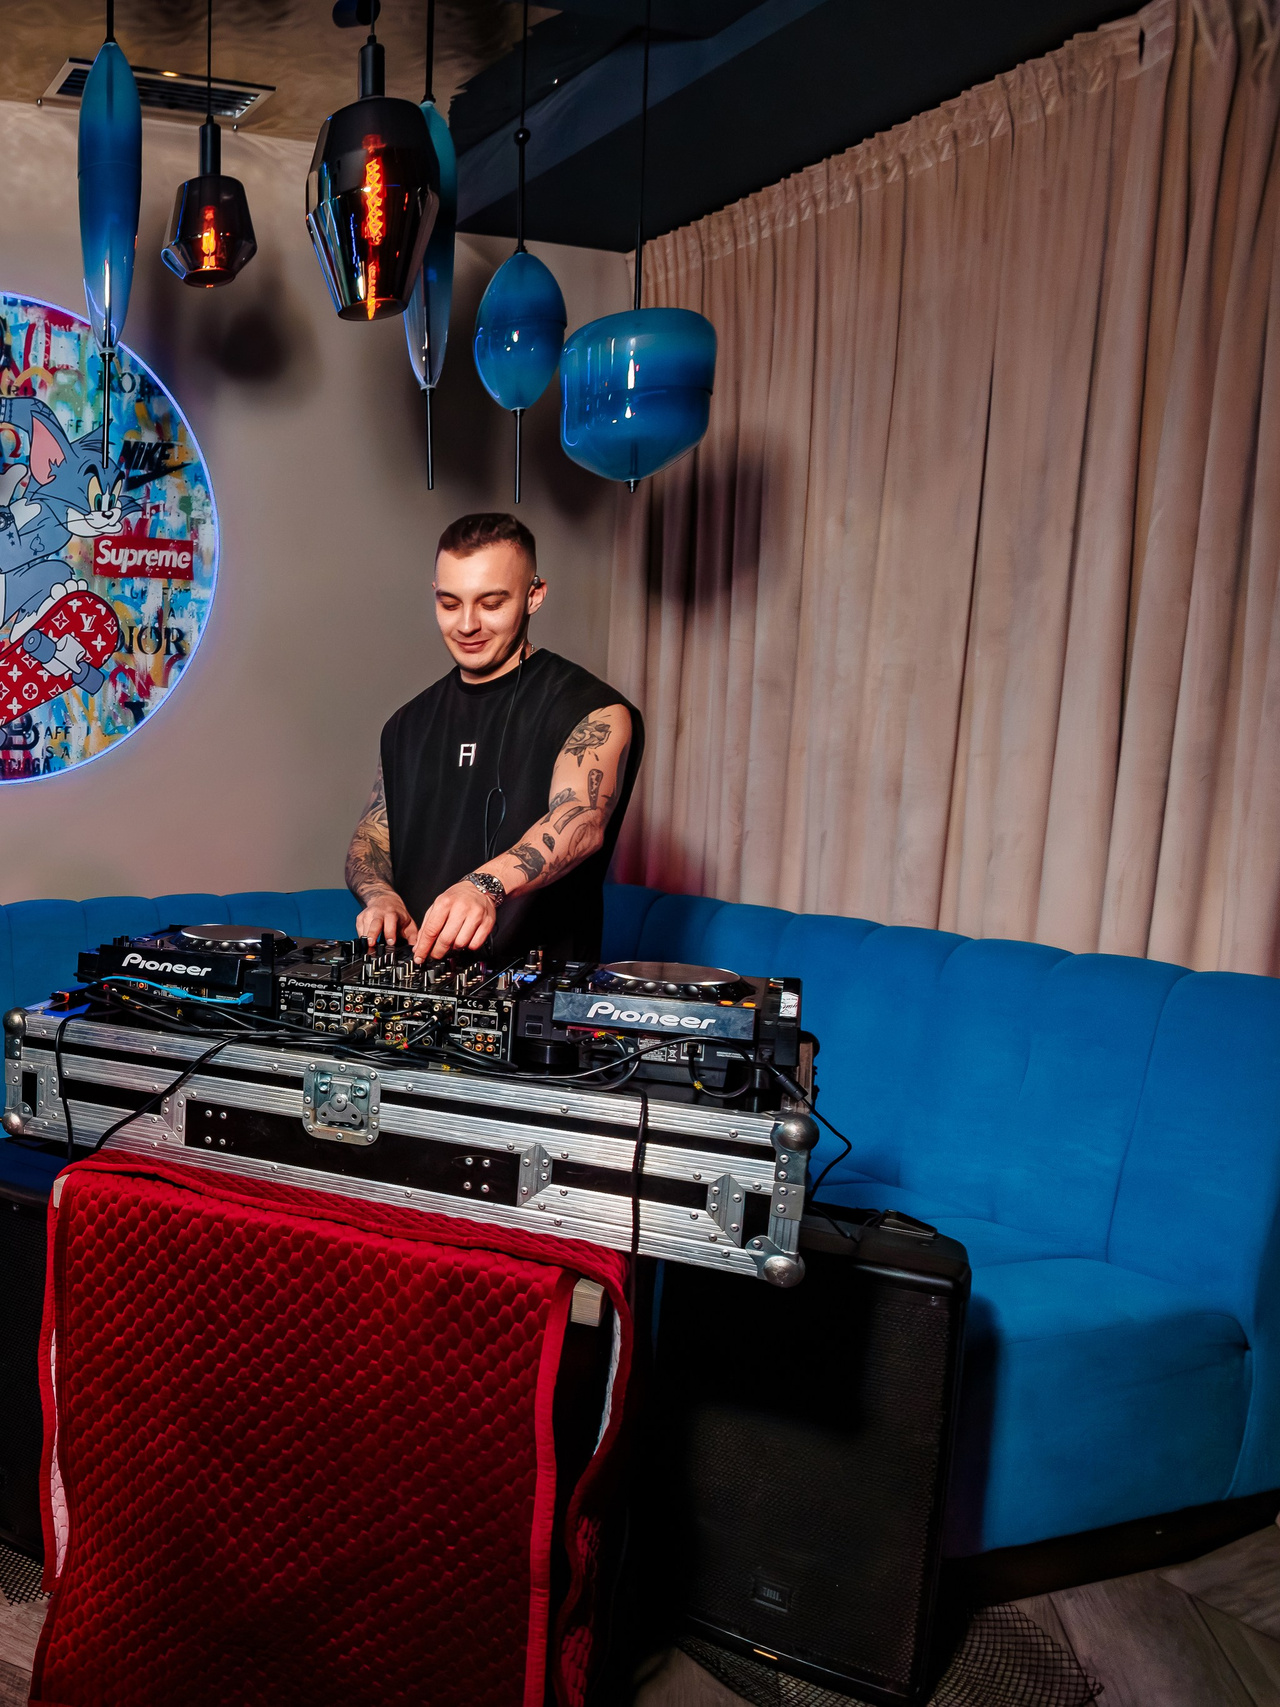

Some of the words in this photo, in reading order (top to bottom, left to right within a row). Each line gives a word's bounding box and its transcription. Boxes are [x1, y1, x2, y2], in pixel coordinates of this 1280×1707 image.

[96, 539, 192, 574] Supreme
[121, 952, 212, 977] Pioneer
[287, 978, 329, 990] Pioneer
[586, 1001, 717, 1030] Pioneer
